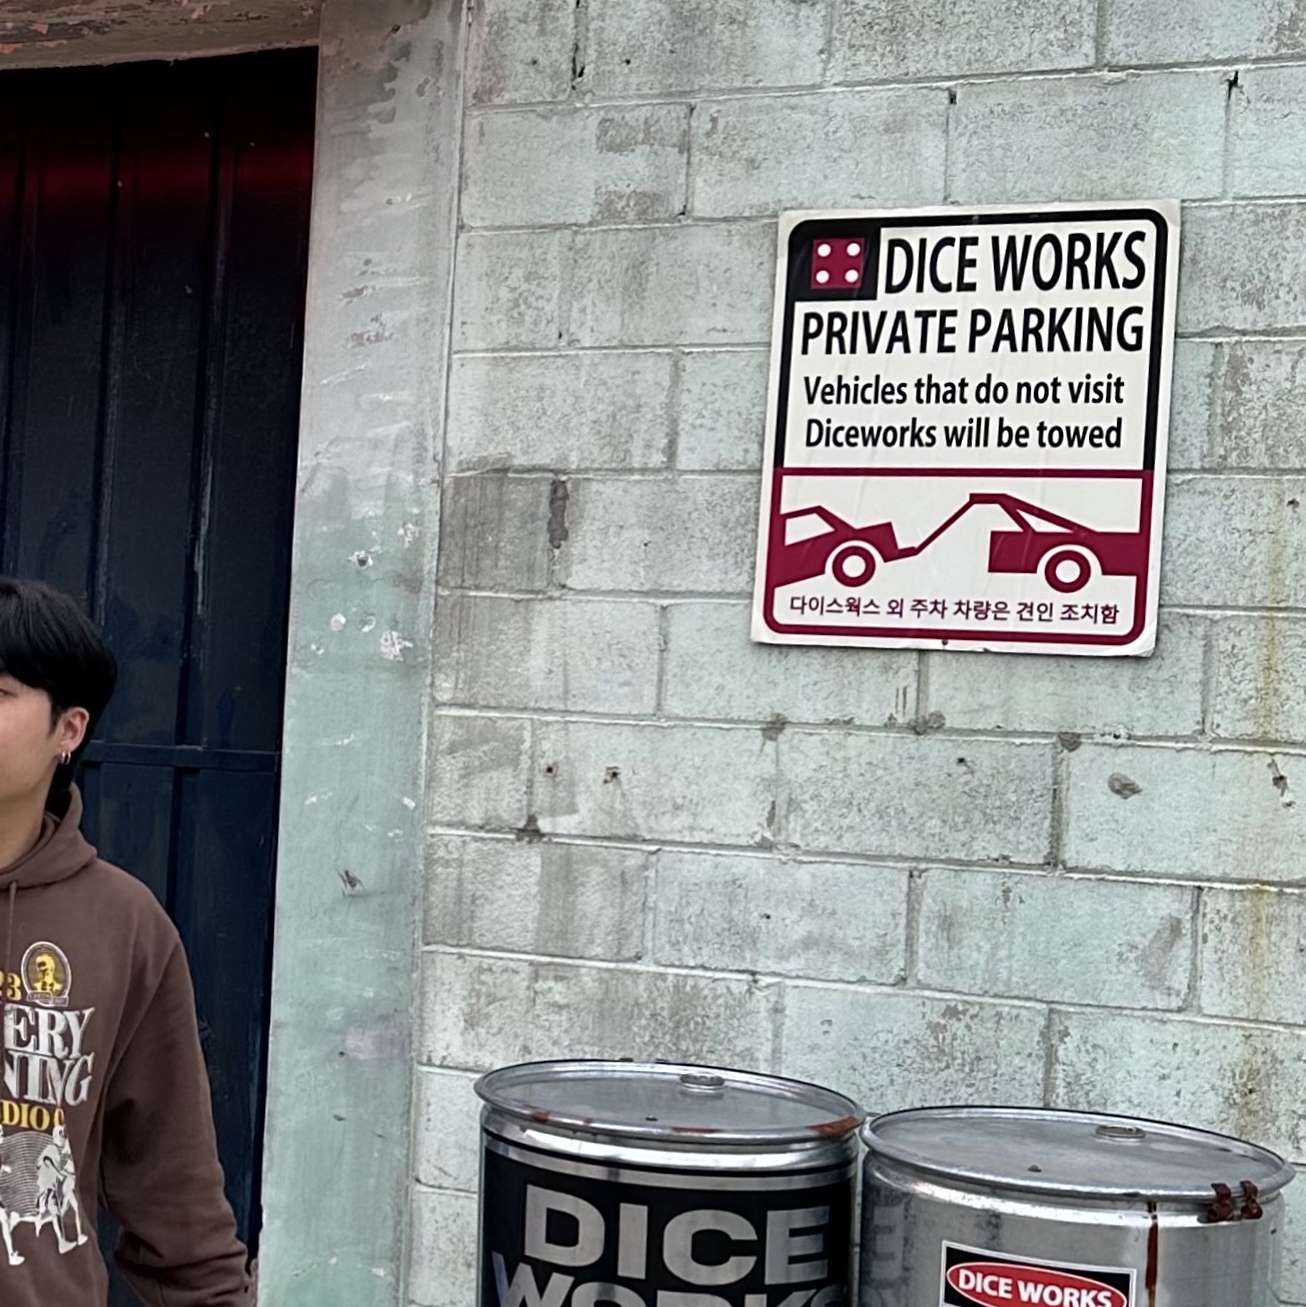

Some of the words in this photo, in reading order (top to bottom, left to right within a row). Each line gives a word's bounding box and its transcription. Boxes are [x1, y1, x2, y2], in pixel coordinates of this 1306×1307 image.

[885, 236, 979, 294] DICE
[991, 230, 1146, 292] WORKS
[801, 309, 958, 355] PRIVATE
[968, 305, 1144, 353] PARKING
[804, 374, 908, 405] Vehicles
[914, 373, 969, 404] that
[975, 373, 1009, 404] do
[1016, 376, 1061, 404] not
[1068, 373, 1125, 404] visit
[805, 417, 937, 448] Diceworks
[944, 417, 990, 448] will
[997, 417, 1030, 448] be
[1037, 417, 1123, 448] towed
[790, 595, 881, 617] 다이스웍스
[886, 598, 904, 618] 외
[910, 599, 948, 619] 주차
[953, 600, 1011, 621] 차량은
[1016, 601, 1054, 622] 견인
[1060, 603, 1119, 624] 조치함
[524, 1184, 830, 1286] DICE
[958, 1268, 1013, 1299] DICE
